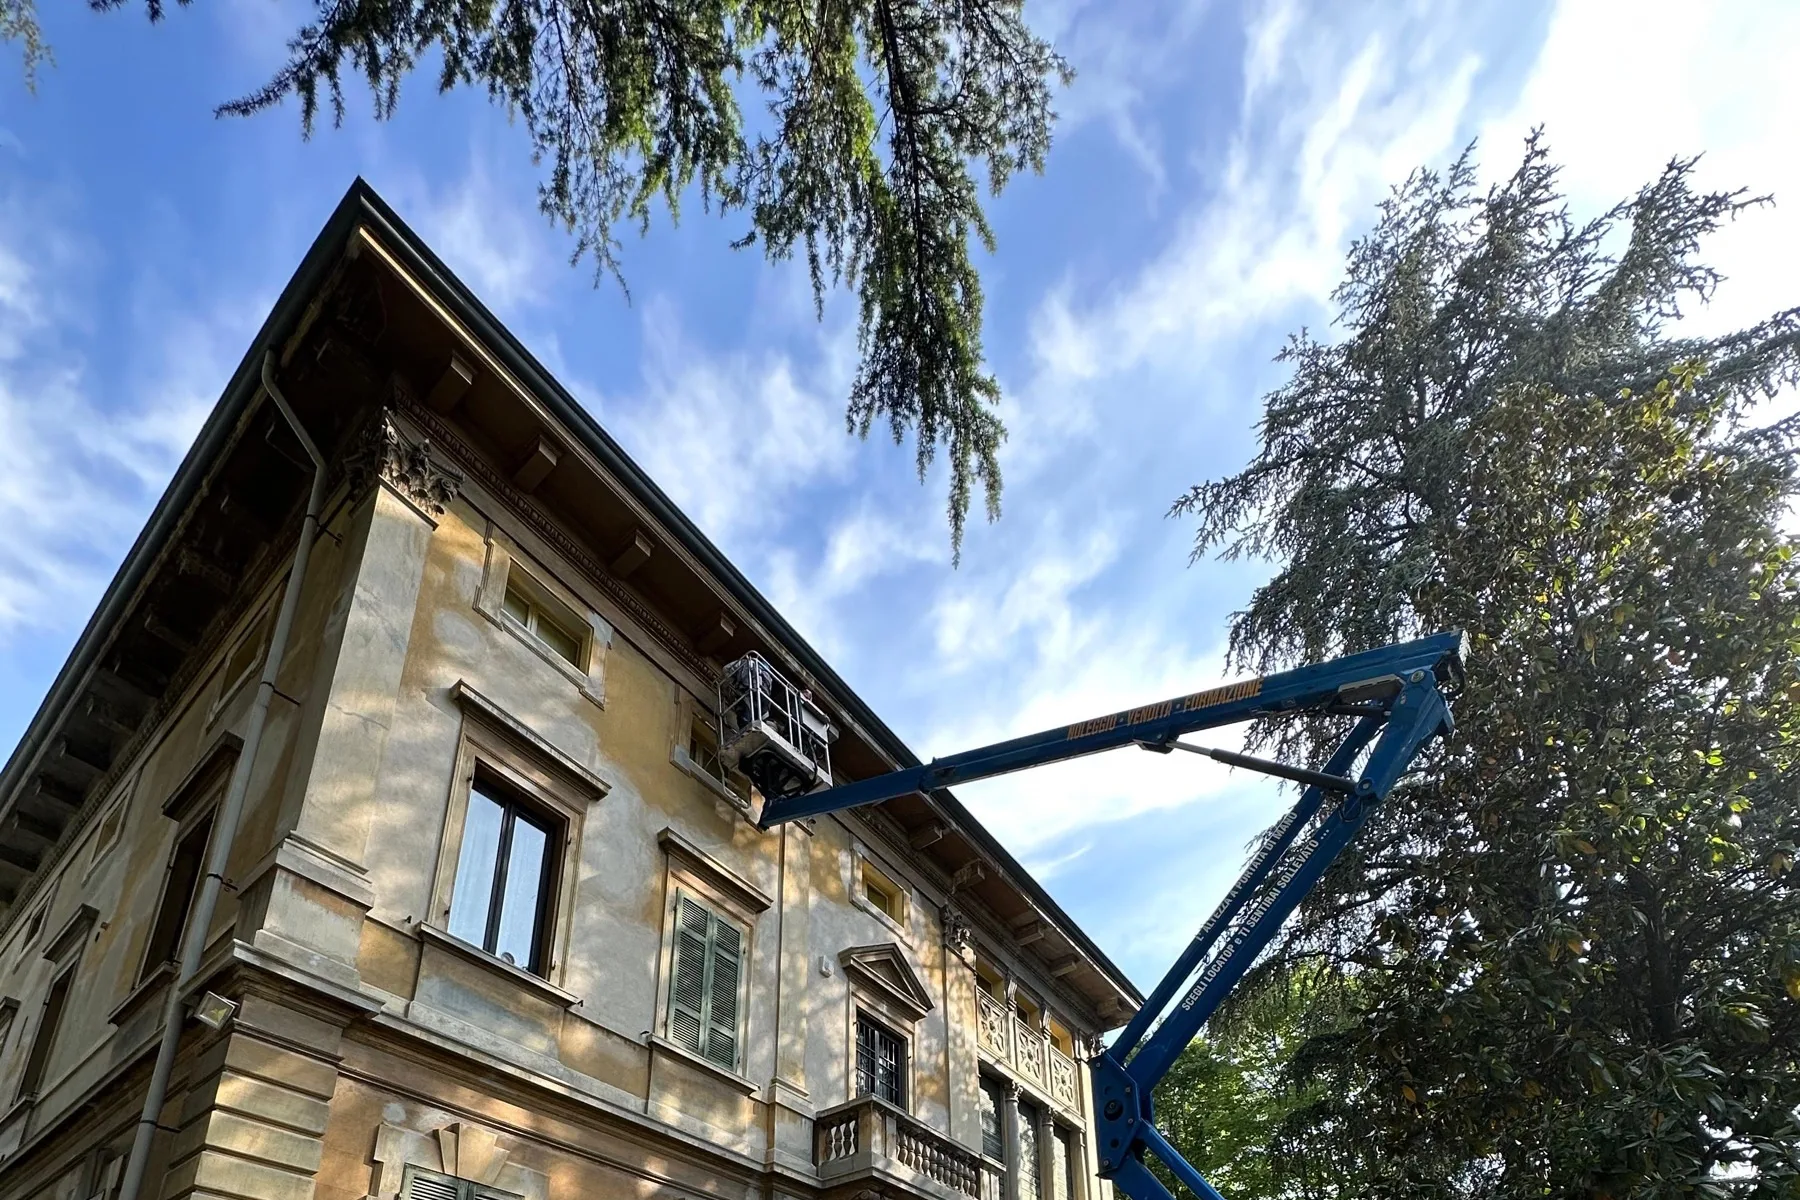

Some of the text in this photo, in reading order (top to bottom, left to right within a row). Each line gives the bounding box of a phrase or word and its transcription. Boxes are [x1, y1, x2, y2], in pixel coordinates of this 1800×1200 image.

[1067, 677, 1265, 741] NOLEGGIO VENDITA FORMAZIONE
[1181, 980, 1208, 1012] SCEGLI
[1203, 943, 1235, 983] LOCATOP
[1238, 926, 1251, 938] TI
[1246, 886, 1282, 928] SENTIRAI
[1276, 839, 1319, 889] SOLLEVATO
[1202, 897, 1233, 934] ALTEZZA
[1230, 889, 1239, 899] A
[1237, 850, 1269, 890] PORTATA
[1264, 839, 1277, 852] DI
[1274, 811, 1298, 841] MANO
